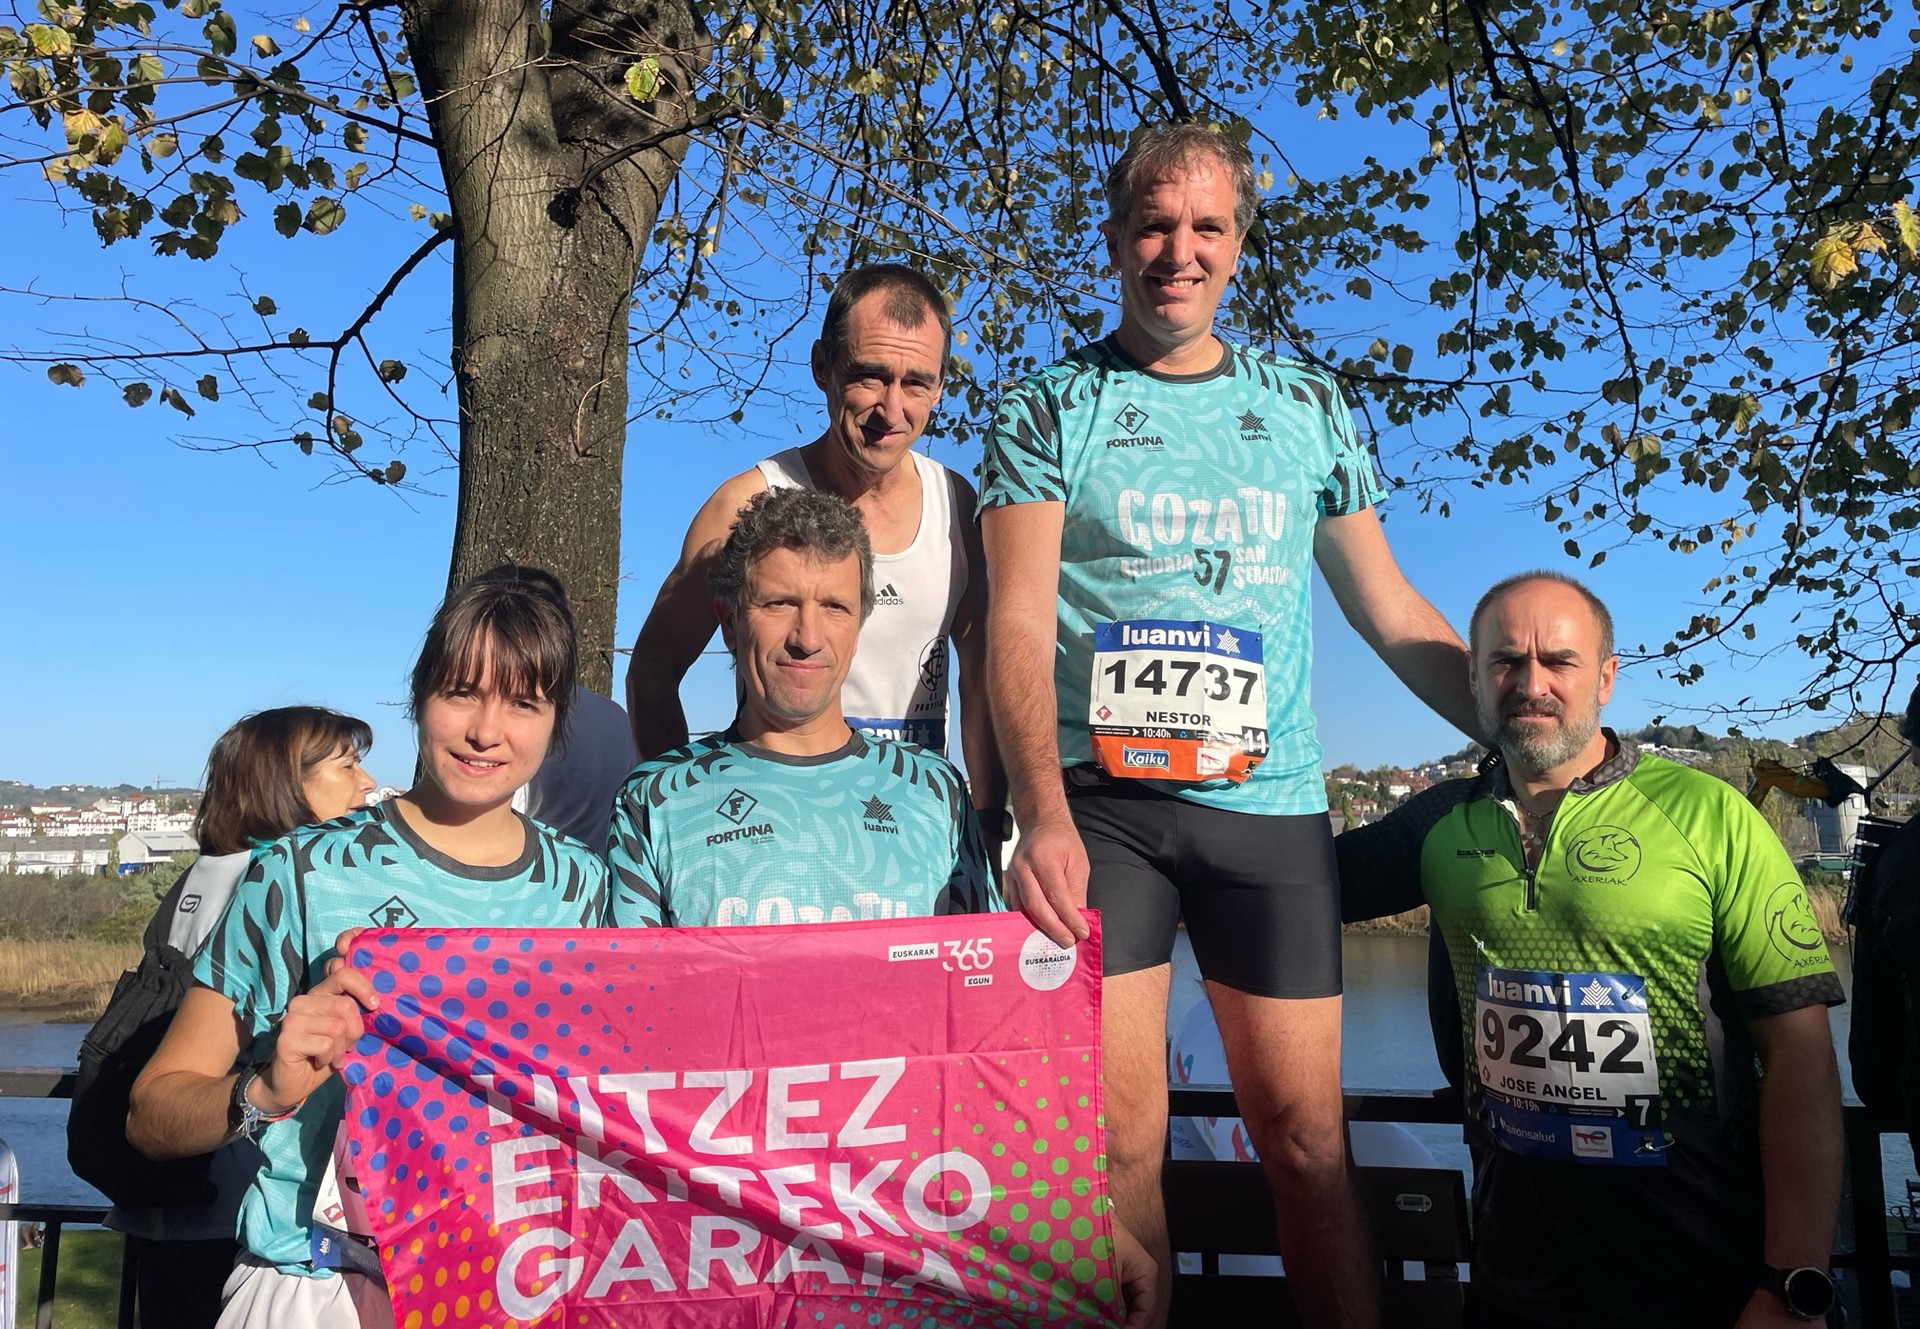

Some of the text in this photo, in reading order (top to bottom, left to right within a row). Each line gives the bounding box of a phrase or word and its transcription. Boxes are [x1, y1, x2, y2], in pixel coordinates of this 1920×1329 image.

[1106, 436, 1164, 449] FORTUNA
[1240, 433, 1272, 442] luanvi
[1117, 486, 1287, 552] GOZATU
[1236, 544, 1267, 563] SAN
[1193, 548, 1231, 596] 57
[873, 597, 904, 606] didas
[1122, 625, 1210, 647] luanvi
[1104, 659, 1258, 706] 14737
[1146, 711, 1211, 727] NESTOR
[1142, 728, 1171, 740] 10:40h
[1245, 730, 1266, 754] 11
[1127, 750, 1166, 767] Kaiku
[706, 823, 774, 847] FORTUNA
[863, 821, 899, 834] luanvi
[1571, 874, 1628, 886] AXERIAK
[892, 947, 936, 959] EUSKARAK
[941, 937, 994, 972] 365
[1792, 954, 1832, 969] AXERIA
[967, 976, 990, 986] EGUN
[1488, 972, 1571, 1006] luanvi
[1481, 1008, 1645, 1075] 9242
[1500, 1075, 1608, 1102] JOSE ANGEL
[1512, 1097, 1540, 1114] 10:19h
[1634, 1098, 1651, 1126] 7
[494, 1214, 972, 1322] GARAIA
